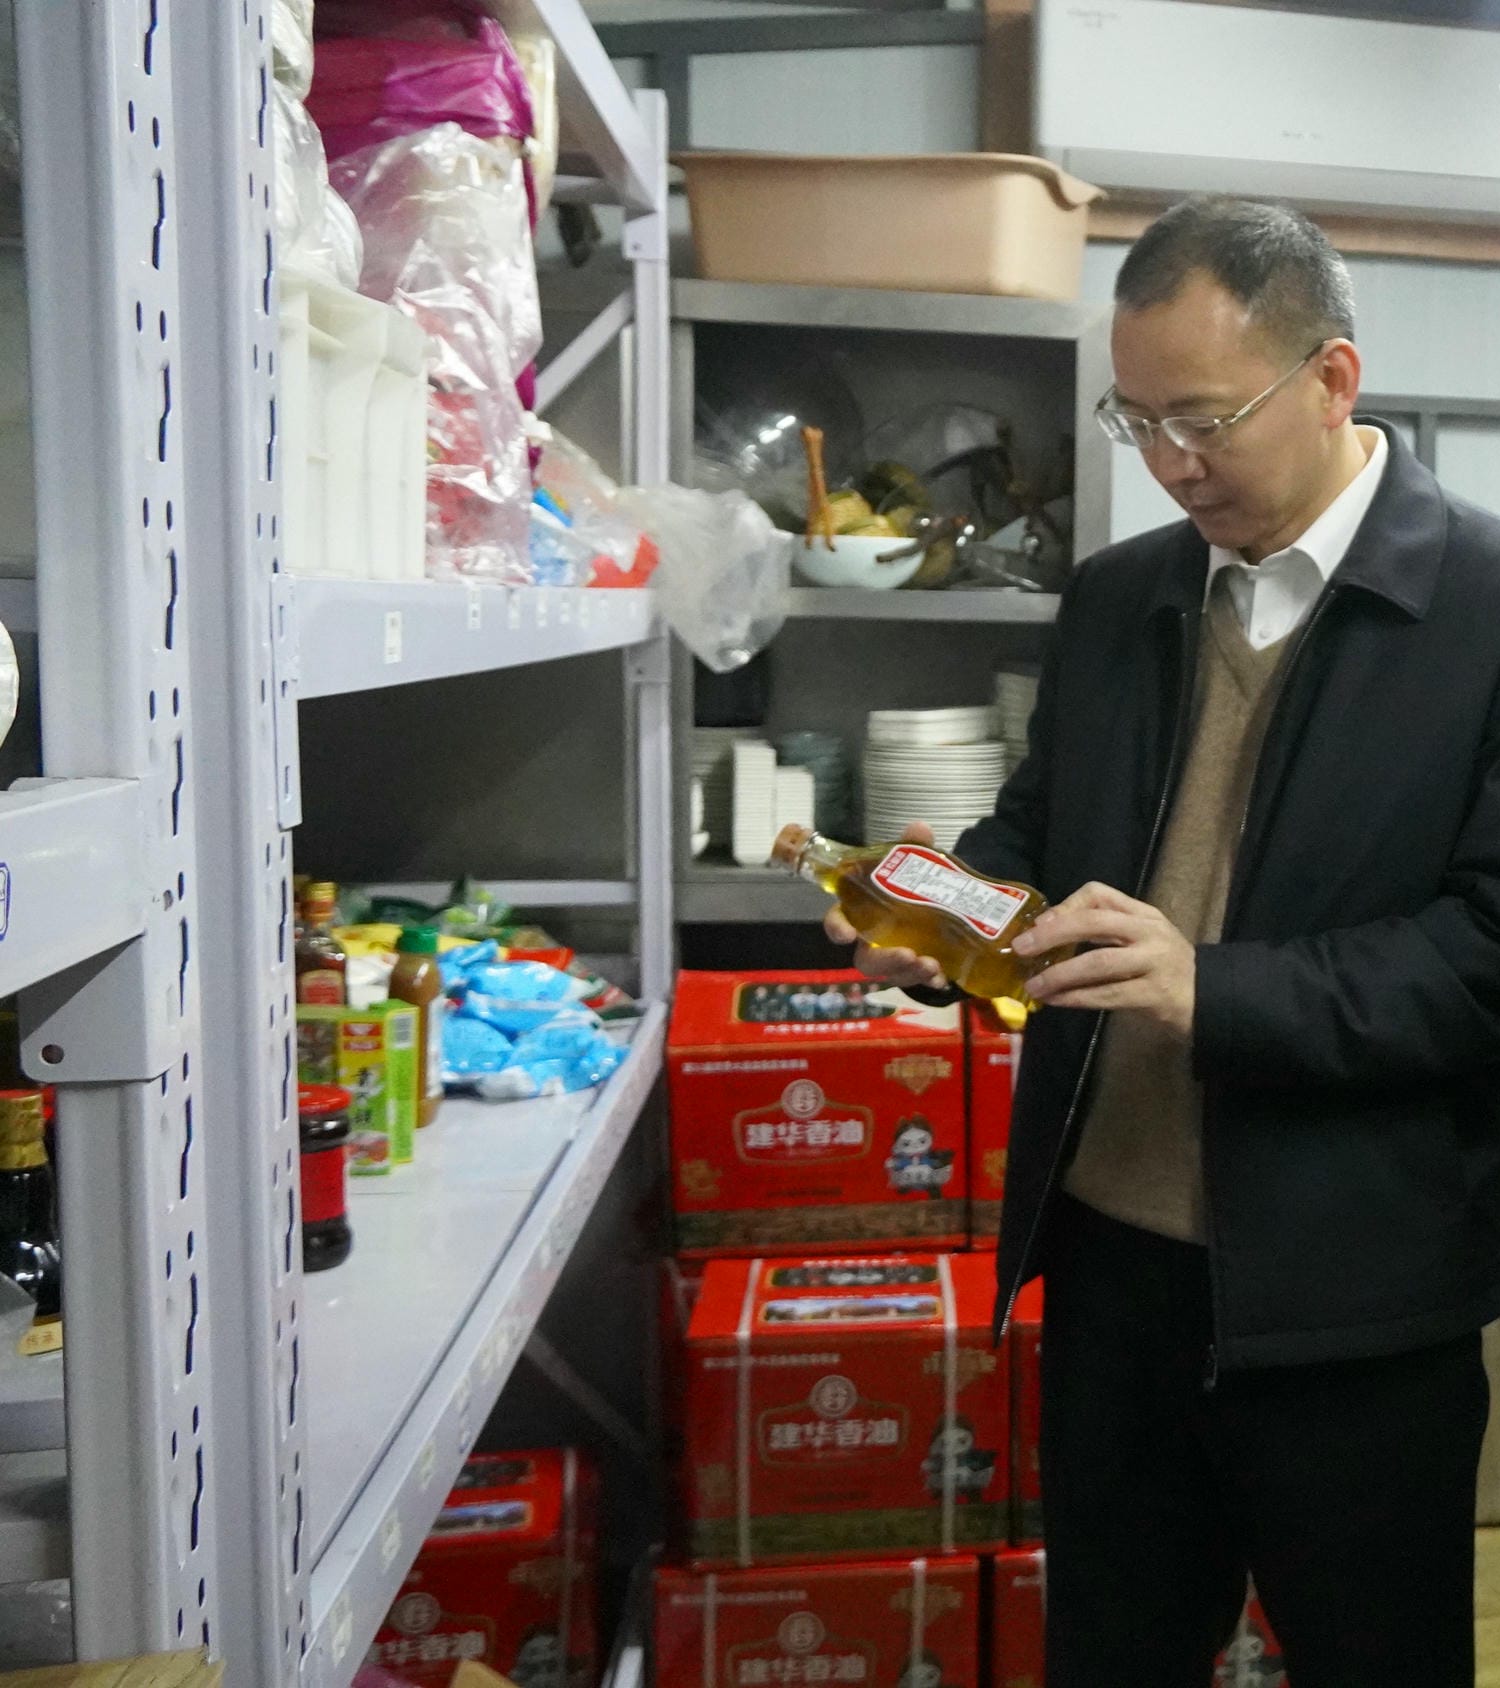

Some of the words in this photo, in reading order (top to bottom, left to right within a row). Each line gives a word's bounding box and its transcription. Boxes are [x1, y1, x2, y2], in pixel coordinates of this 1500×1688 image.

[745, 1119, 864, 1149] 建华香油
[769, 1418, 898, 1451] 建华香油
[738, 1653, 866, 1684] 建华香油
